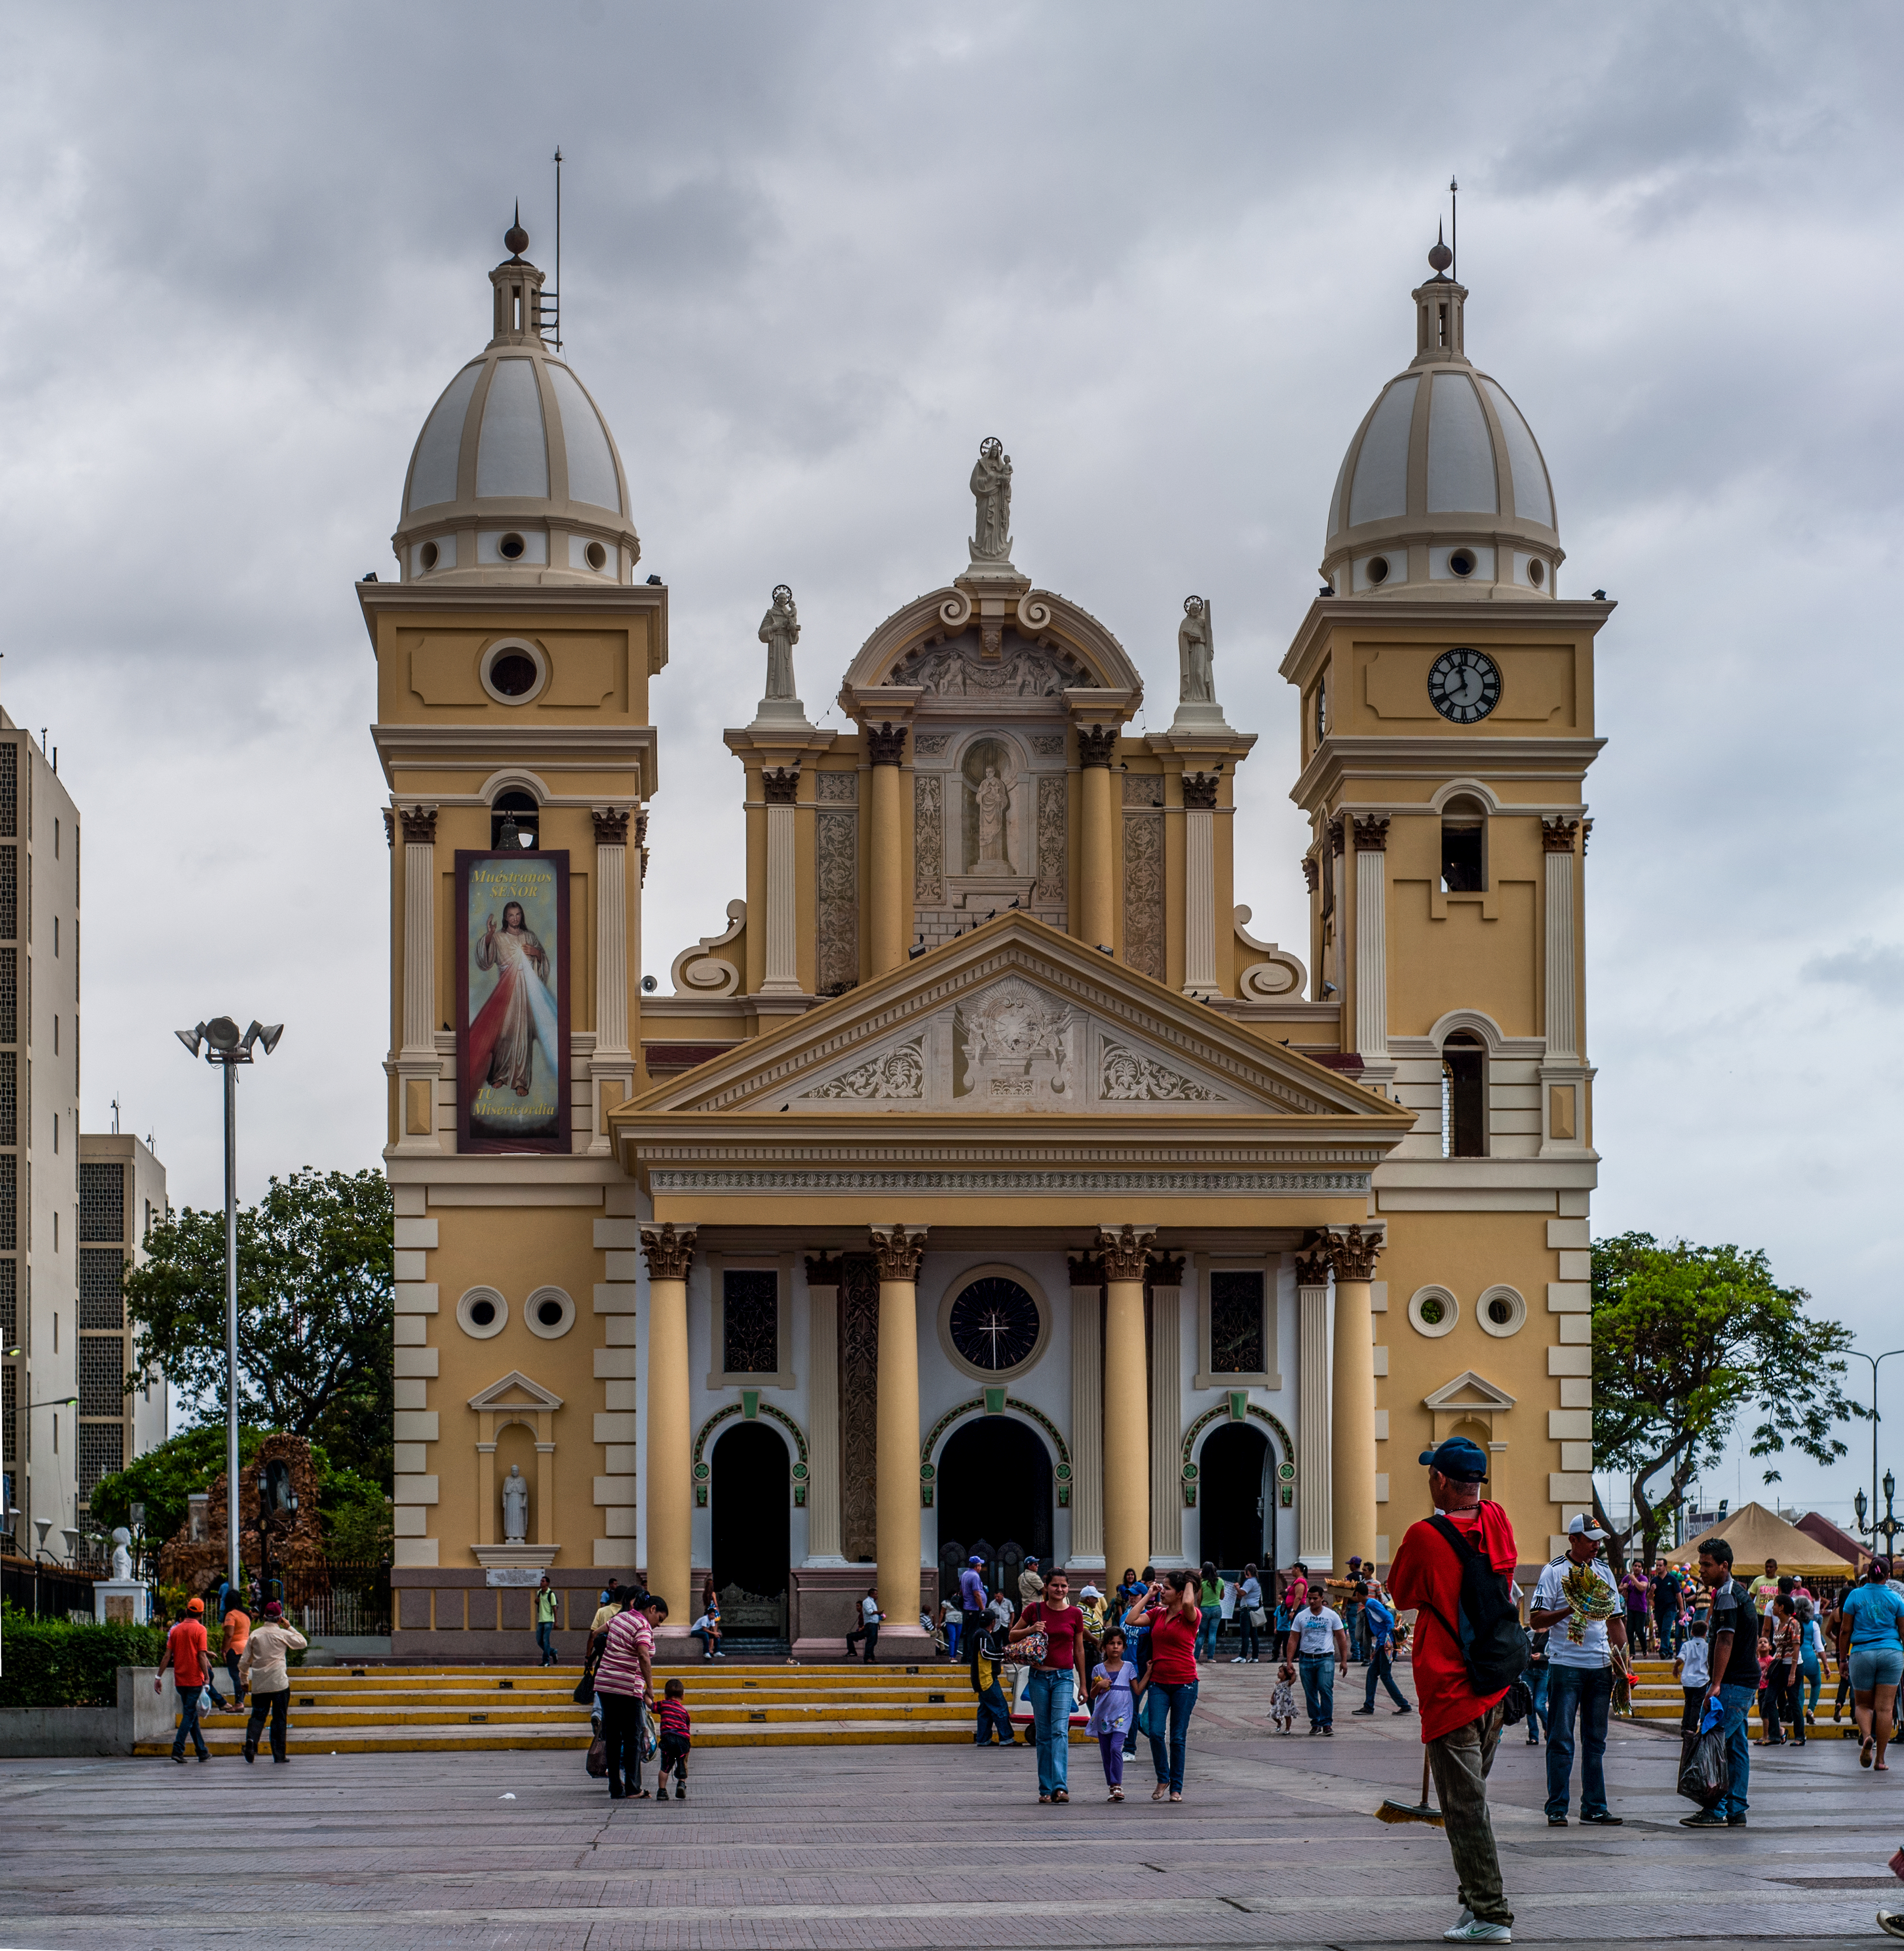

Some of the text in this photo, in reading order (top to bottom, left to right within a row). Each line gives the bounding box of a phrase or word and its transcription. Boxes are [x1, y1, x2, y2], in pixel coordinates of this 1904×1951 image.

[471, 870, 552, 883] Muéstranos
[490, 884, 538, 898] SEÑOR
[478, 1088, 496, 1100] TU
[472, 1103, 554, 1115] Misericordia
